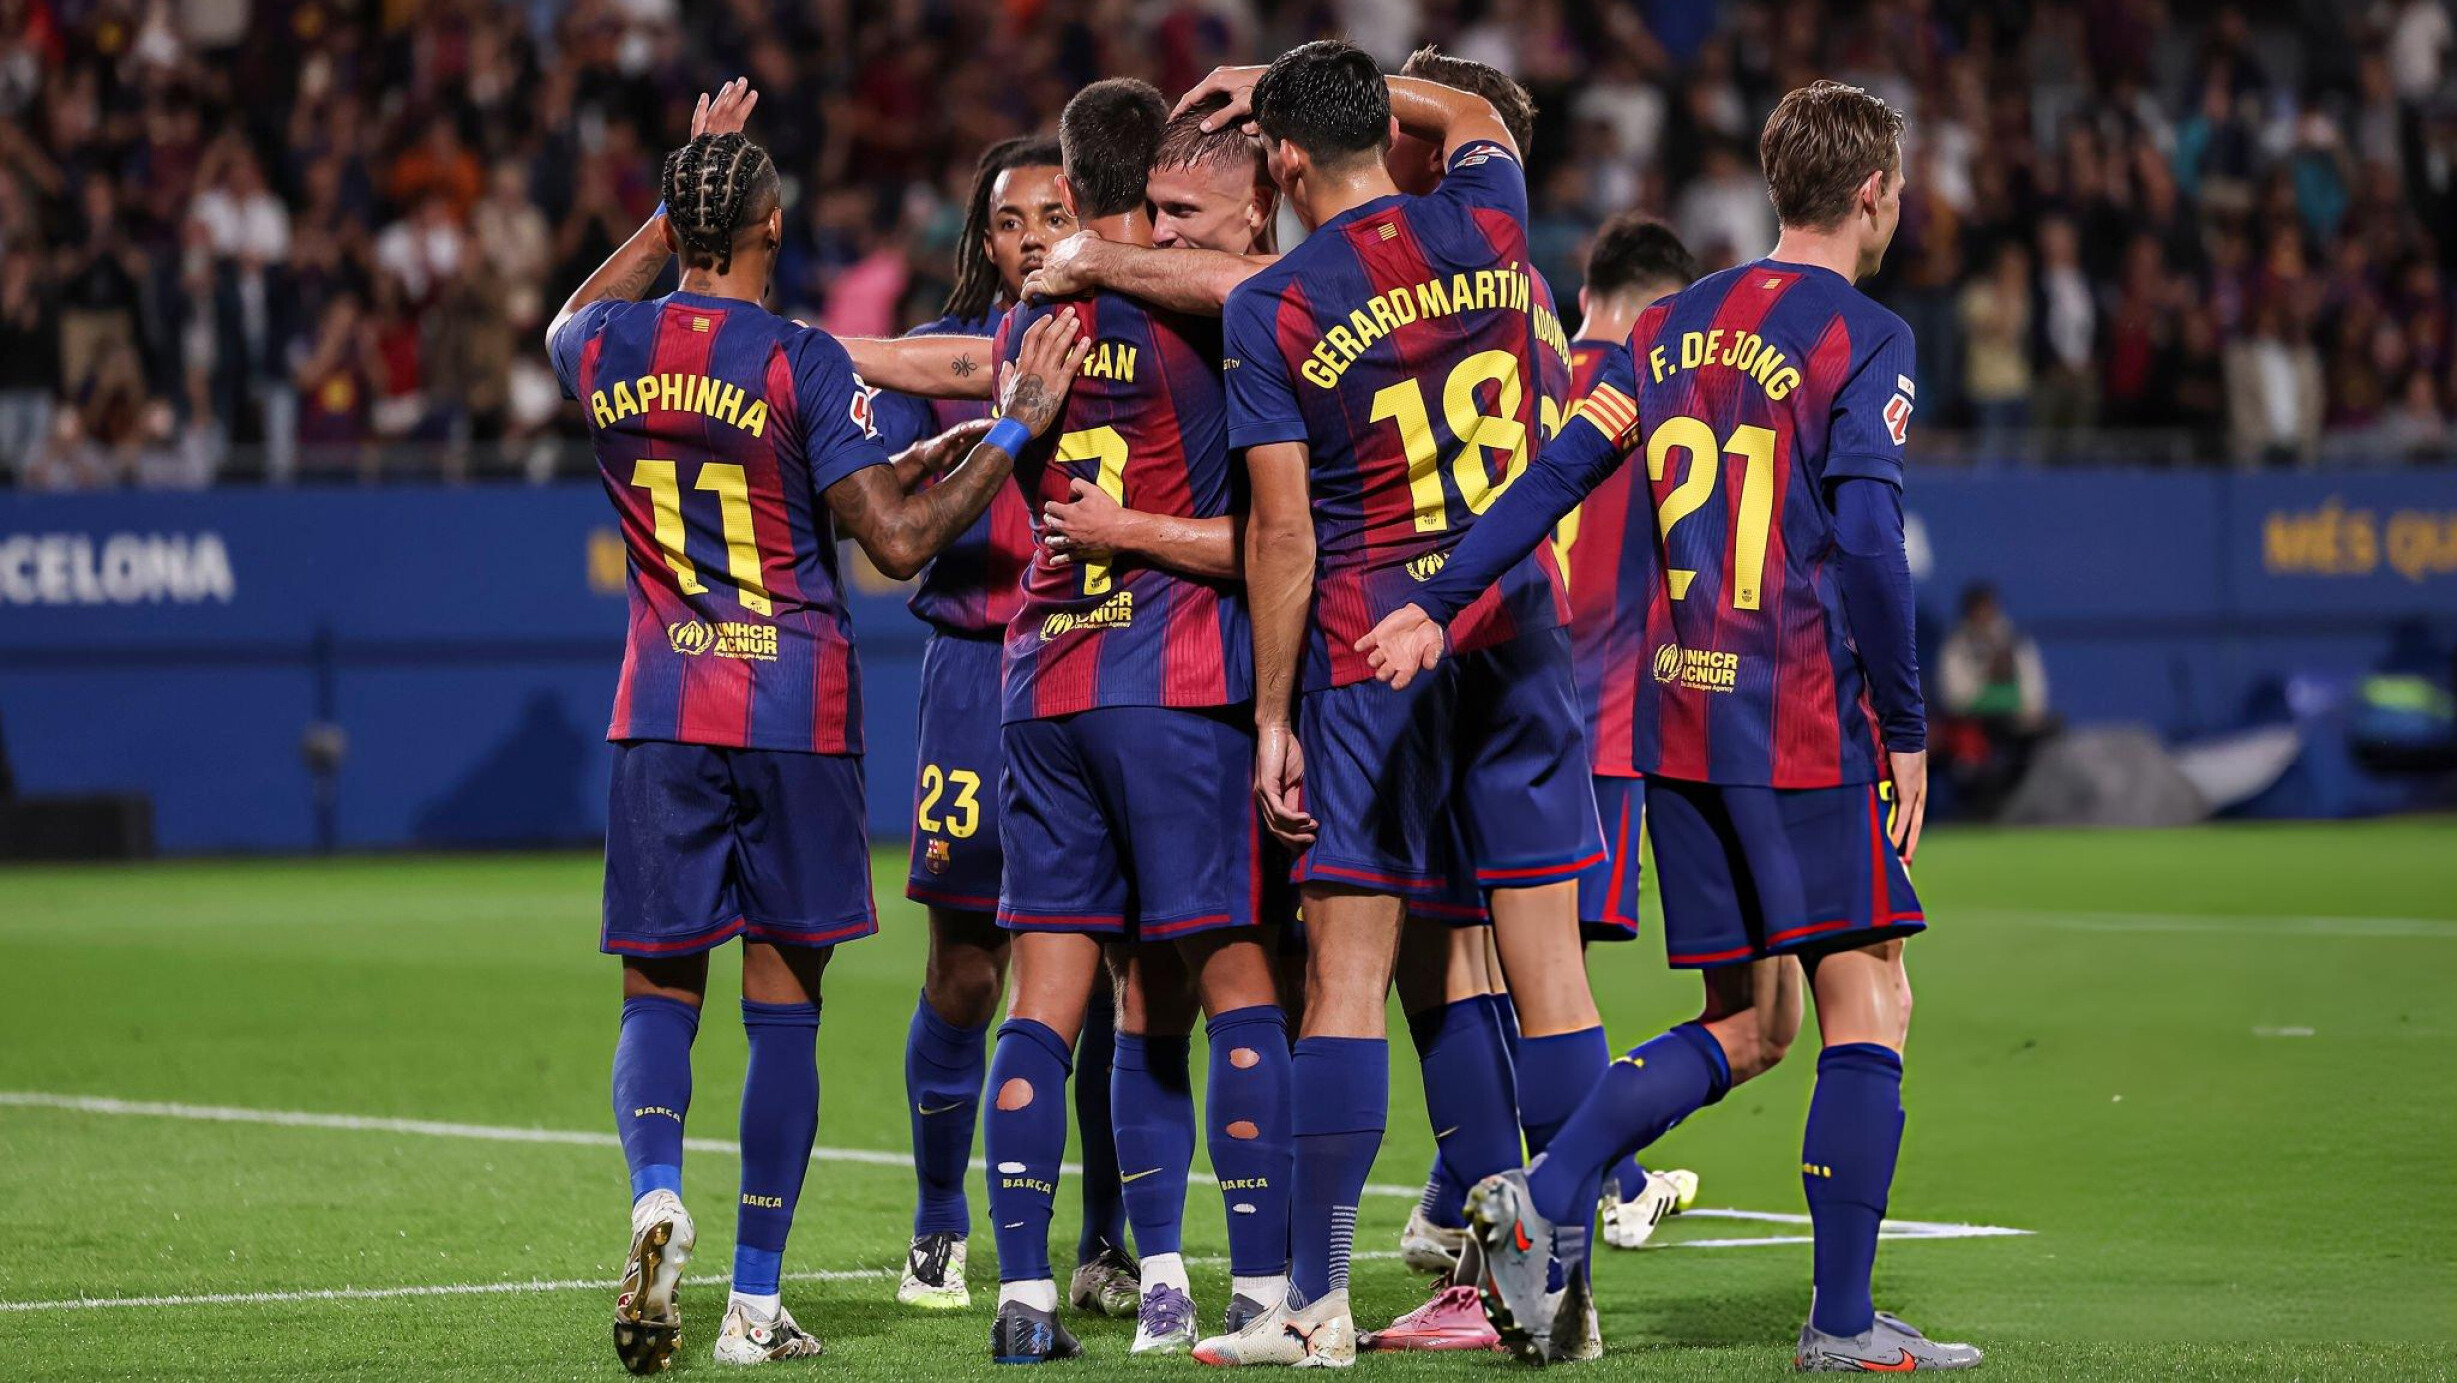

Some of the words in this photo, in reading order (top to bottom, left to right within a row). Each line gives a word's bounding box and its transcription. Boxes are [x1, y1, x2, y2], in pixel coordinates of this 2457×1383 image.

[1650, 344, 1677, 385] F.
[591, 373, 769, 438] RAPHINHA
[1369, 349, 1528, 533] 18
[630, 459, 773, 617] 11
[1055, 425, 1129, 595] 7
[1646, 416, 1777, 611] 21
[714, 637, 778, 655] ACNUR
[918, 764, 981, 838] 23
[742, 1193, 782, 1208] BARÇA
[1002, 1178, 1051, 1195] BARÇA
